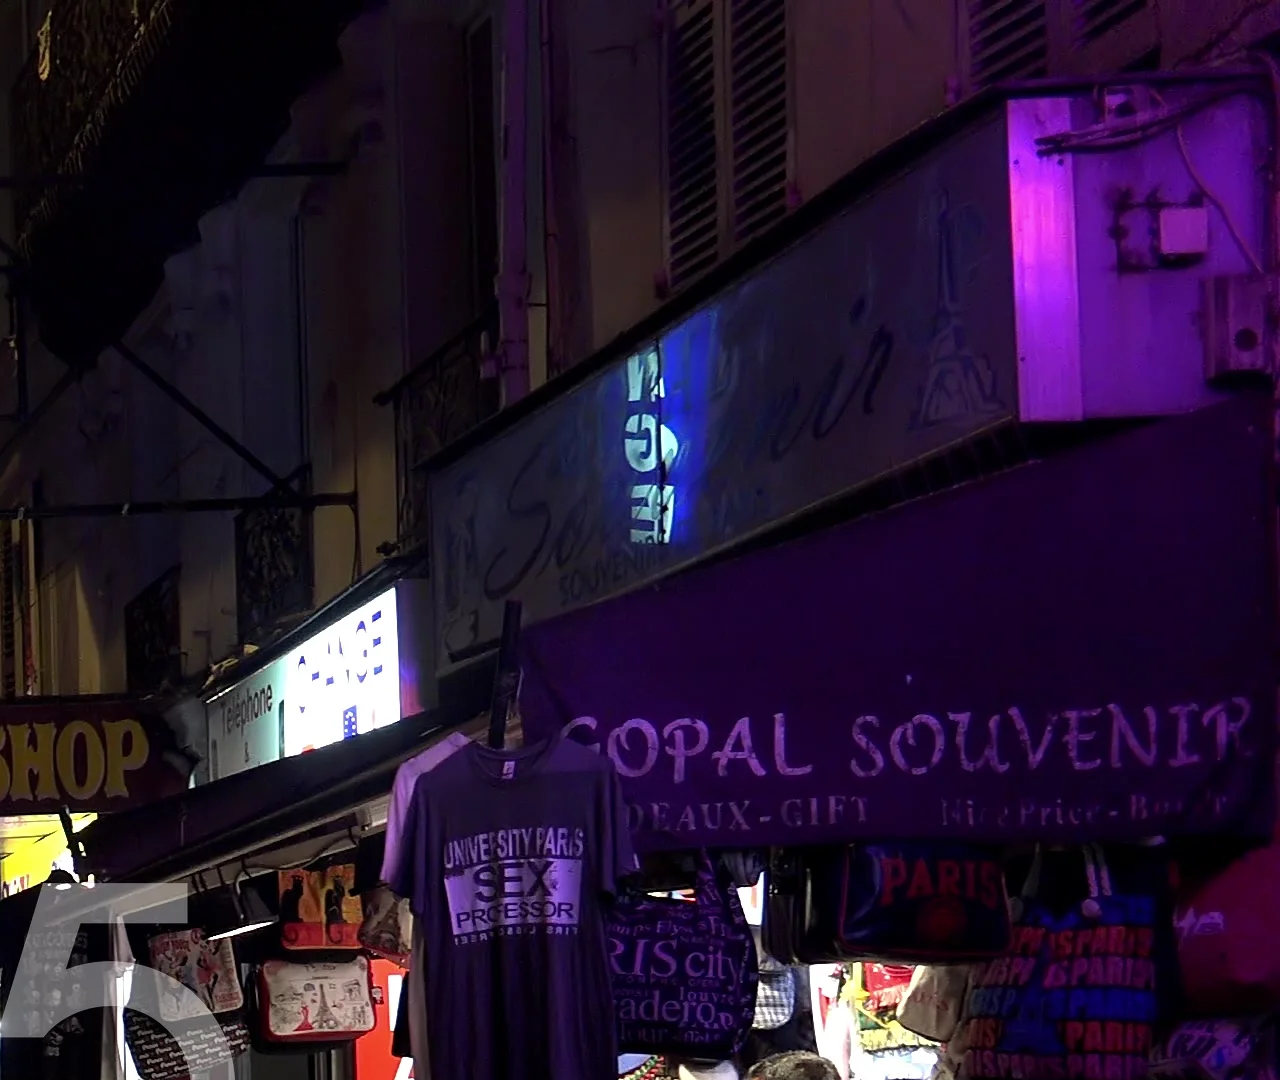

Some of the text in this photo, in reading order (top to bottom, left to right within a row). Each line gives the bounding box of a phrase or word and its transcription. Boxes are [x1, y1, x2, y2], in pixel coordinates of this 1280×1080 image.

[473, 860, 555, 903] SEX
[879, 855, 1000, 911] PARIS
[684, 945, 738, 992] city
